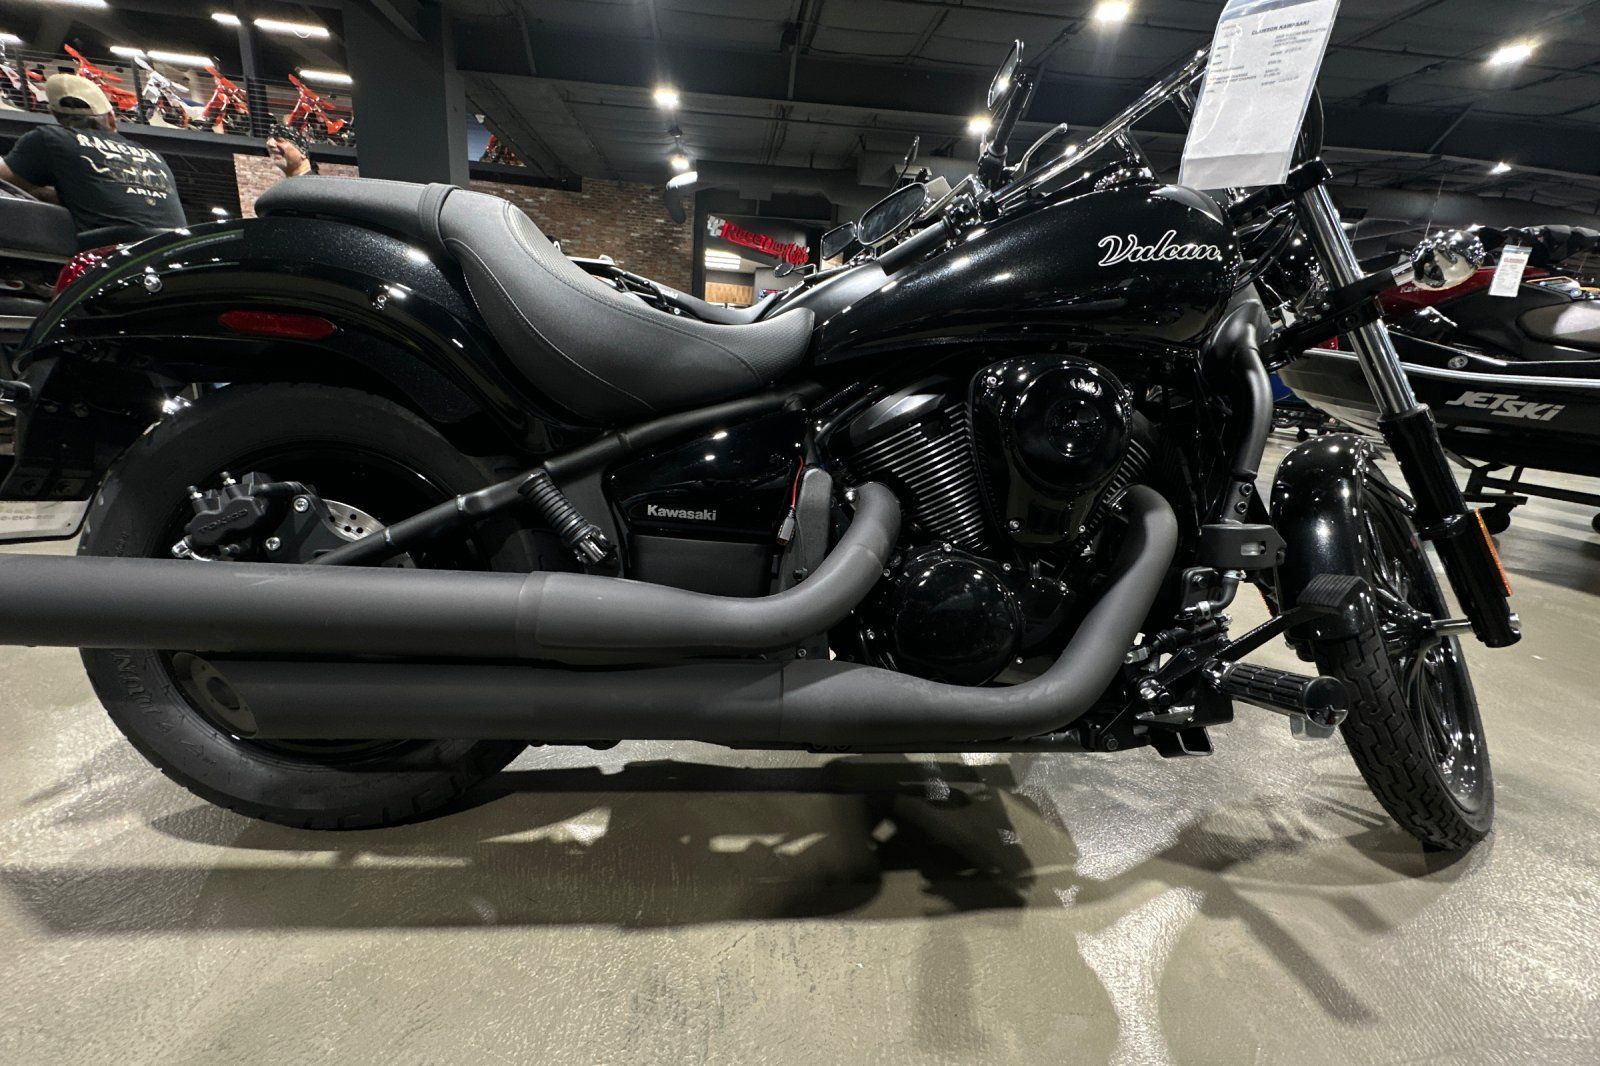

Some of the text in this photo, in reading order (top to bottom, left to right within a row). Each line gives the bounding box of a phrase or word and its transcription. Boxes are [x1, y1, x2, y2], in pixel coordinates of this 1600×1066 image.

[126, 187, 168, 199] ARIAT
[1098, 229, 1222, 267] Vulcan
[647, 504, 717, 521] Kawasaki
